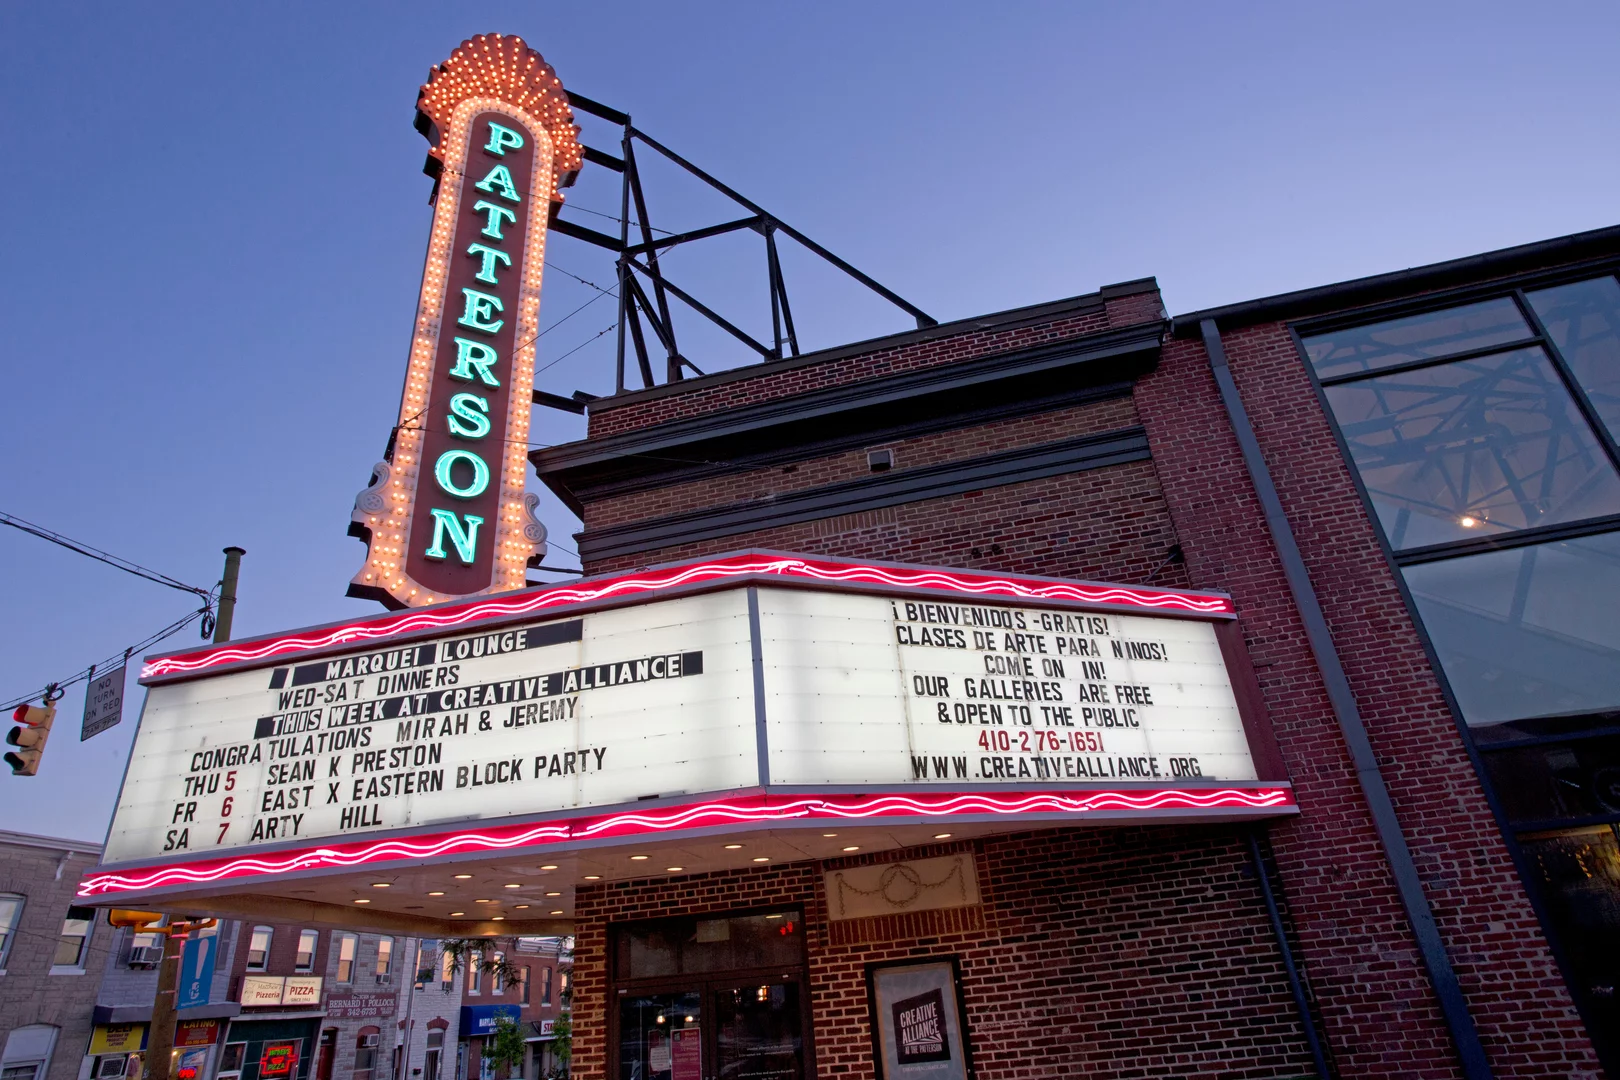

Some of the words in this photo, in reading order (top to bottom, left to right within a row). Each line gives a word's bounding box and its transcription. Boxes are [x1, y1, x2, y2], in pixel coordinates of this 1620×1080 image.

[424, 120, 524, 567] PATTERSON
[905, 602, 1027, 629] BIENVENIDOS
[442, 630, 528, 662] LOUNGE
[895, 625, 967, 649] CLASES
[973, 630, 996, 651] DE
[1004, 633, 1047, 654] ARTE
[1056, 636, 1101, 657] PARA
[1111, 640, 1168, 661] NINOS!
[984, 654, 1034, 677] COME
[1042, 658, 1065, 678] ON
[1082, 661, 1107, 680] IN!
[93, 688, 115, 706] TURN
[98, 678, 112, 691] NO
[271, 713, 320, 736] THIS
[328, 701, 386, 725] WEEK
[398, 694, 428, 717] AT
[440, 676, 549, 711] CREATIVE
[564, 655, 681, 693] ALLIANCE
[278, 679, 365, 711] WED-SAT
[377, 665, 460, 696] DINNERS
[913, 675, 949, 698] OUR
[964, 677, 1063, 701] GALLERIES
[1079, 683, 1110, 704] ARE
[1115, 684, 1154, 705] FREE
[86, 708, 97, 721] ON
[102, 697, 120, 713] RED
[1007, 705, 1031, 726] TO
[1040, 706, 1073, 727] THE
[1083, 708, 1140, 728] PUBLIC
[190, 727, 372, 773] CONGRATULATIONS
[396, 713, 469, 743] MIRAH
[478, 710, 492, 731] &
[503, 697, 578, 728] JEREMY
[978, 729, 1105, 752] 410-276-1651
[184, 773, 221, 797] THU
[224, 770, 237, 792] 5
[267, 760, 316, 786] SEAN
[329, 756, 342, 777] K
[351, 743, 442, 774] PRESTON
[172, 801, 197, 824] FR
[221, 796, 234, 817] 6
[261, 785, 314, 813] EAST
[327, 782, 340, 804] X
[352, 769, 444, 801] EASTERN
[456, 759, 523, 789] BLOCK
[534, 747, 607, 779] PARTY
[163, 827, 189, 851] SA
[216, 823, 229, 845] 7
[251, 814, 304, 842] ARTY
[339, 803, 383, 830] HILL
[289, 986, 314, 995] PIZZA
[328, 999, 360, 1008] BERNARD
[368, 998, 395, 1007] POLLOCK
[183, 1020, 216, 1029] LATINO
[900, 1002, 938, 1028] CREATIVE
[902, 1017, 940, 1045] ALLIANCE
[919, 1043, 943, 1053] PATTERSON
